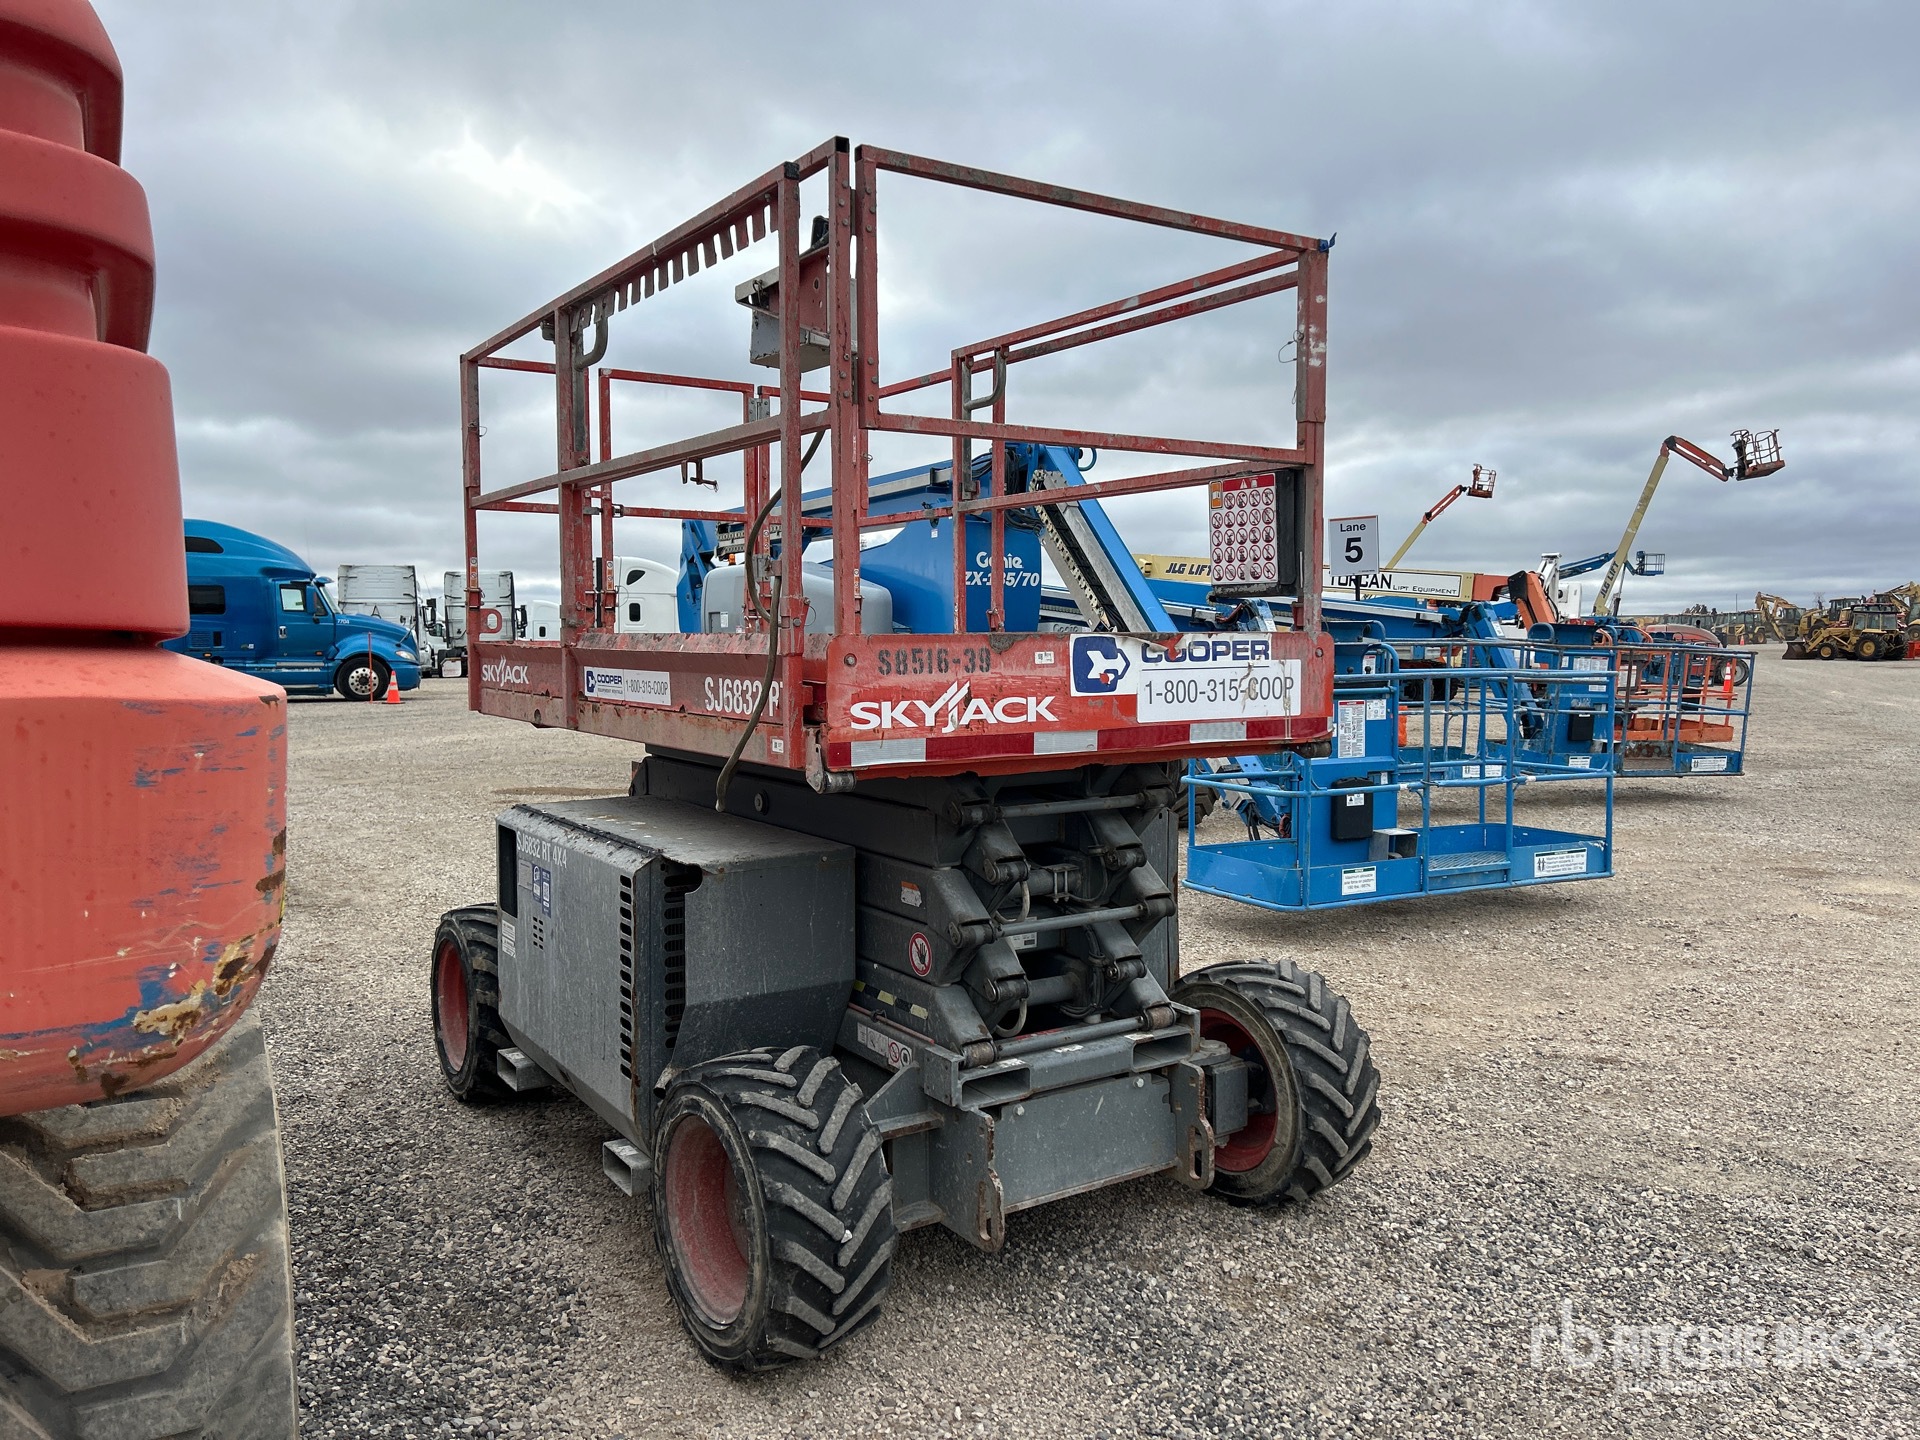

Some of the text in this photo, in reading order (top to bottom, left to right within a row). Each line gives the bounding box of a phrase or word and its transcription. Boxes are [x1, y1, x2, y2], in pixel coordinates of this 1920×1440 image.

[1340, 523, 1366, 533] Lane
[1344, 536, 1363, 563] 5
[1165, 562, 1187, 575] JLG
[1600, 560, 1619, 598] JLG LIFT
[1412, 585, 1457, 595] EQUIPMENT
[482, 655, 529, 687] SKYJACK
[597, 674, 622, 685] COOPER
[850, 679, 1060, 734] SKYJACK
[516, 830, 568, 869] SJ6832 RT 4X4
